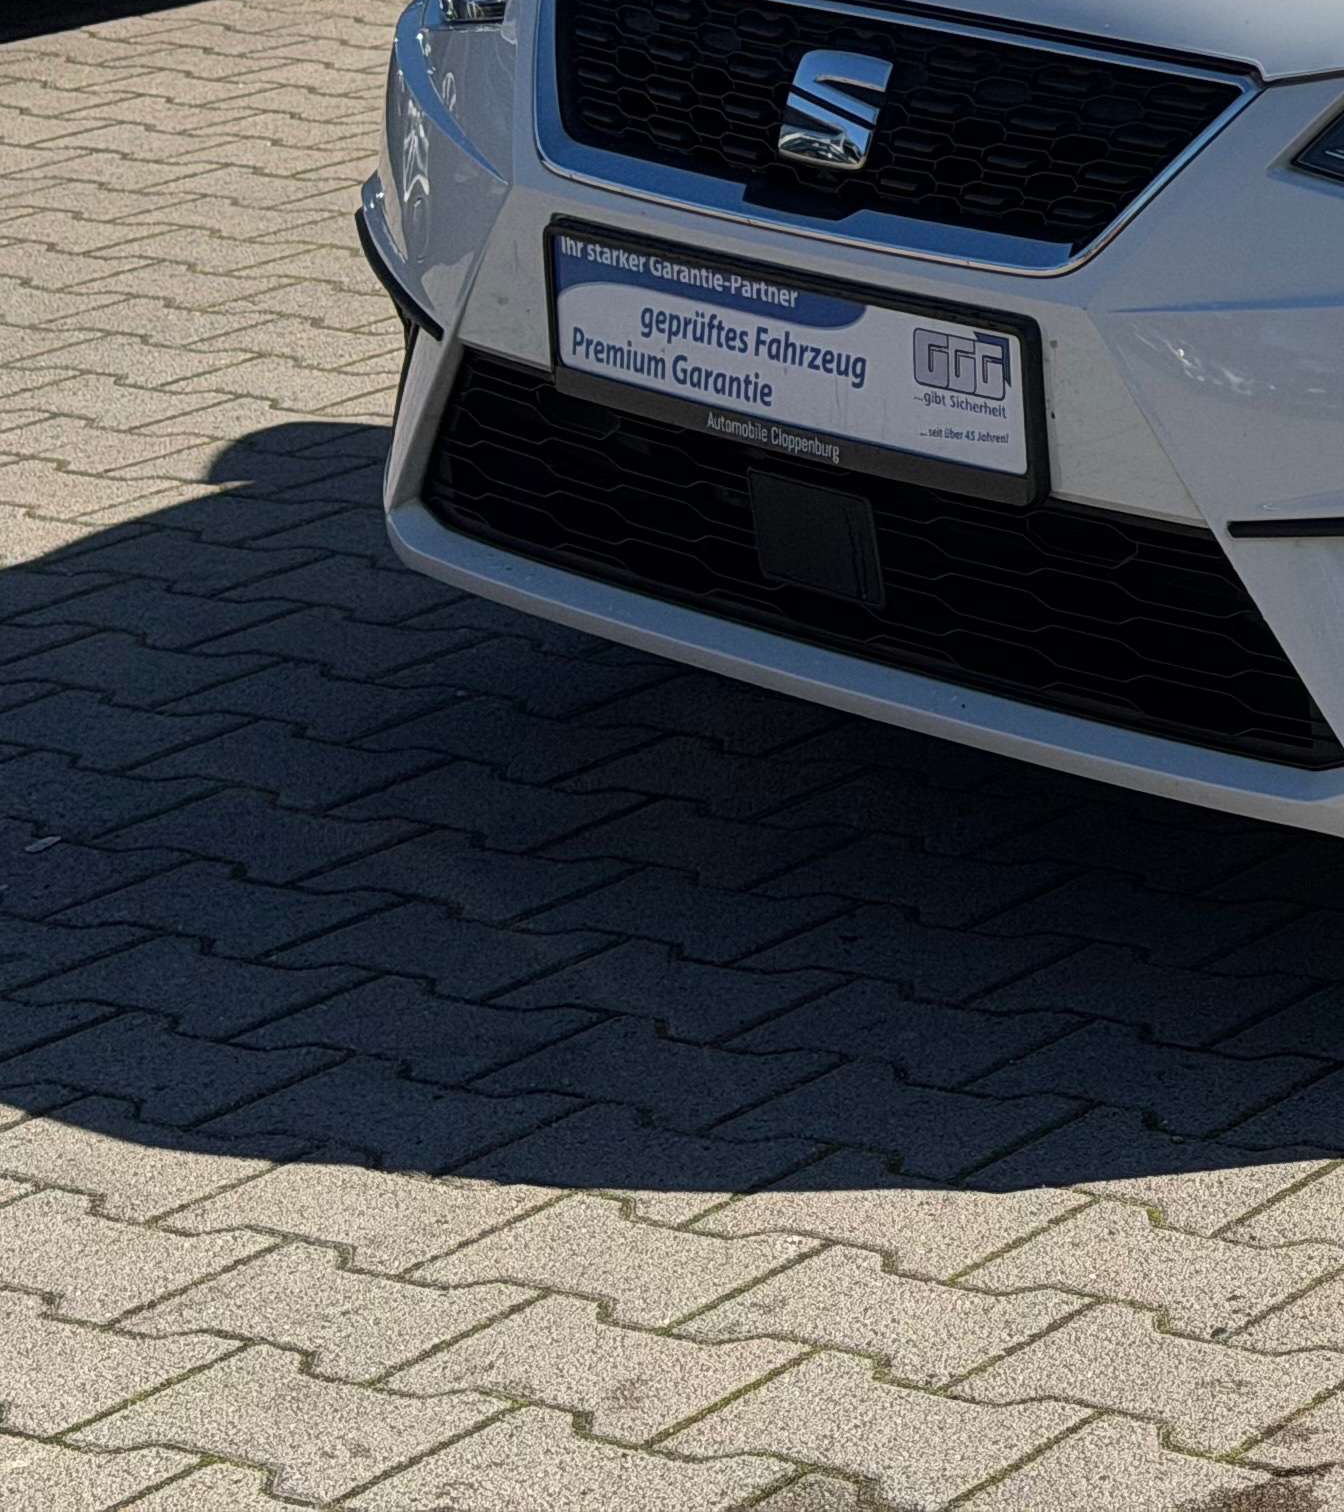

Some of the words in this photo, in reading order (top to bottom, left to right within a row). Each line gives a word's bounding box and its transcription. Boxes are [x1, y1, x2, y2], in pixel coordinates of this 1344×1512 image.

[561, 236, 585, 258] Ihr
[587, 243, 647, 274] starker
[649, 256, 799, 309] Garantie-Partner
[572, 326, 667, 381] Premium
[672, 354, 774, 407] Garantie
[641, 306, 750, 354] geprüftes
[754, 326, 867, 389] Fahrzeug
[706, 411, 769, 443] Automobile
[771, 426, 841, 465] Cloppenburg
[950, 394, 1008, 420] Sicherheit
